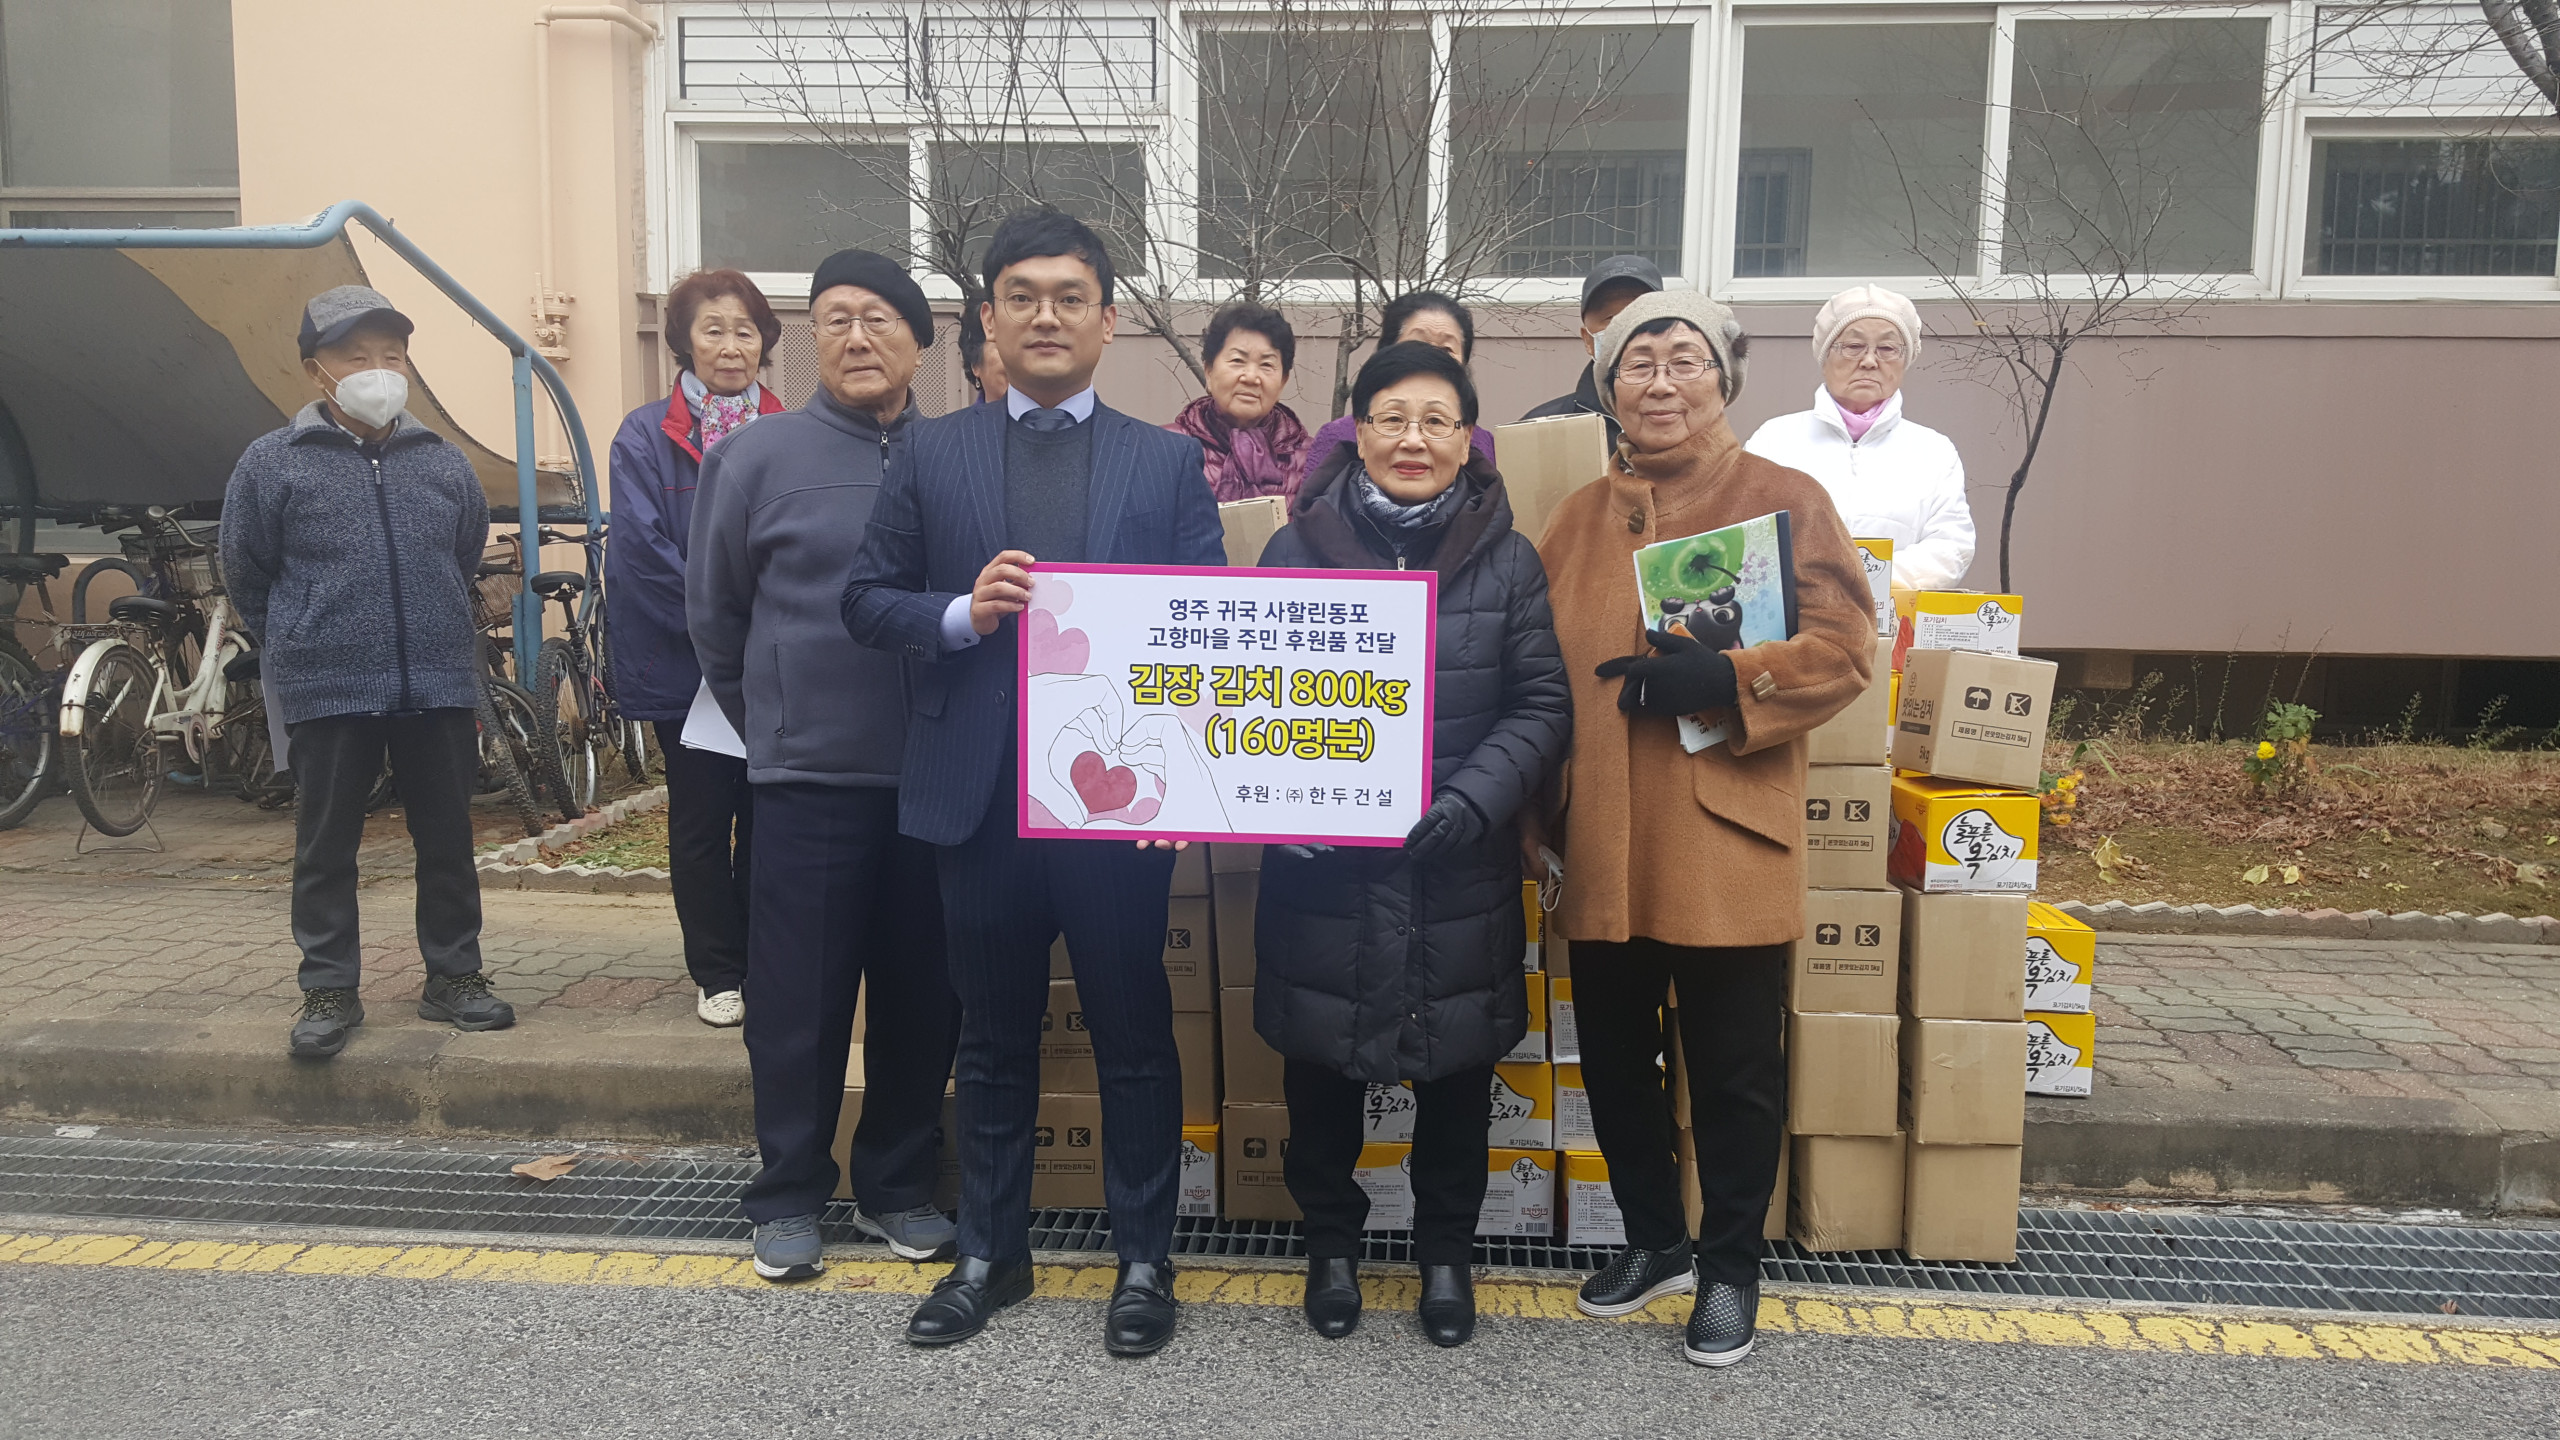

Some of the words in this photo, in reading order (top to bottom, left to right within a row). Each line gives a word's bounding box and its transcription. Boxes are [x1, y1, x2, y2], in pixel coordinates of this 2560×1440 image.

[1169, 599, 1210, 621] 영주
[1217, 600, 1257, 622] 귀국
[1264, 601, 1369, 625] 사할린동포
[1923, 616, 1947, 624] 포기김치
[1147, 626, 1230, 650] 고향마을
[1237, 628, 1277, 651] 주민
[1284, 629, 1348, 653] 후원품
[1354, 631, 1396, 654] 전달
[1128, 663, 1203, 706] 김장
[1210, 665, 1282, 708] 김치
[1290, 669, 1411, 716] 800kg
[1902, 698, 1934, 720] 맛있는김치
[1205, 713, 1375, 762] (160명분)
[1919, 745, 1930, 764] 5kg
[1235, 785, 1269, 803] 후원
[1953, 816, 1994, 846] 늘푸른
[1996, 881, 2032, 889] 포기김치/5kg
[2026, 946, 2051, 969] 푸른
[2027, 1031, 2051, 1053] 푸른
